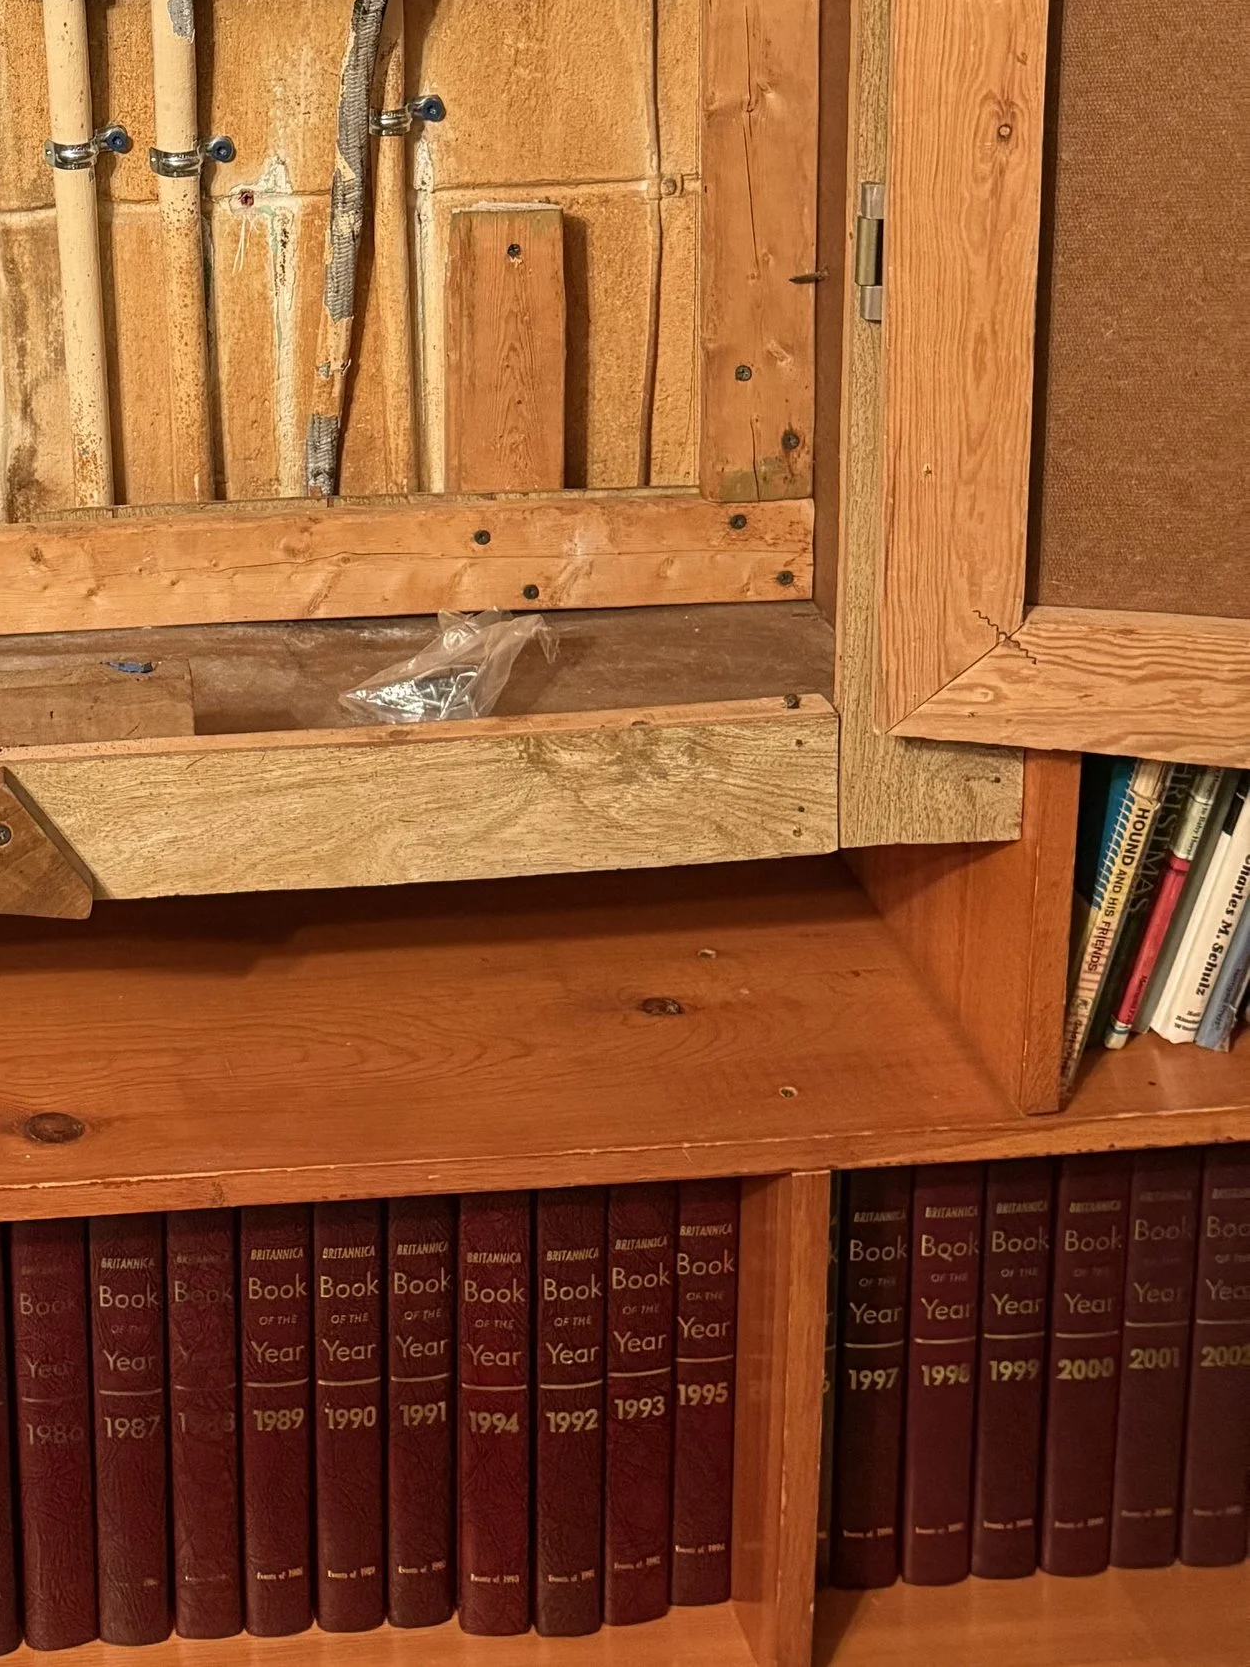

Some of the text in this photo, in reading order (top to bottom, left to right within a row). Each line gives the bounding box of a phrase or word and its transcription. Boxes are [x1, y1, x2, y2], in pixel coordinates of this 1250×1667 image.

[1129, 767, 1190, 913] HRISTMAS
[1087, 807, 1150, 972] HOUND AND HIS FRIENDS
[1214, 920, 1233, 940] M.
[1196, 944, 1223, 996] Schulz
[680, 1224, 733, 1236] BRITANNICA
[1135, 1217, 1191, 1241] Book
[397, 1241, 448, 1255] BRITANNICA
[615, 1236, 667, 1250] BRITANNICA
[850, 1236, 907, 1262] Book
[921, 1234, 979, 1259] Book
[992, 1231, 1049, 1253] Book
[1065, 1229, 1122, 1252] Book
[251, 1247, 304, 1260] BRITANNICA
[323, 1246, 375, 1259] BRITANNICA
[468, 1251, 521, 1264] BRITANNICA
[547, 1248, 599, 1262] BRITANNICA
[676, 1251, 733, 1276] Book
[249, 1275, 307, 1301] Book
[321, 1272, 379, 1299] Book
[395, 1268, 451, 1295] Book
[612, 1264, 670, 1290] Book
[100, 1286, 158, 1309] Book
[465, 1279, 525, 1303] Book
[544, 1276, 602, 1301] Book
[1134, 1283, 1182, 1303] Year
[850, 1302, 902, 1324] Year
[922, 1297, 972, 1320] Year
[991, 1293, 1042, 1315] Year
[1065, 1293, 1112, 1314] Year
[678, 1317, 730, 1339] Year
[251, 1341, 305, 1364] Year
[323, 1339, 376, 1362] Year
[397, 1336, 448, 1359] Year
[546, 1342, 599, 1364] Year
[614, 1331, 666, 1353] Year
[106, 1350, 155, 1372] Year
[468, 1344, 521, 1367] Year
[1130, 1348, 1179, 1370] 2001
[849, 1368, 899, 1390] 1997
[990, 1360, 1039, 1380] 1999
[1058, 1358, 1114, 1380] 2000
[678, 1383, 728, 1405] 1995
[254, 1408, 304, 1431] 1989
[326, 1406, 376, 1429] 1990
[400, 1402, 446, 1426] 1991
[615, 1397, 664, 1420] 1993
[104, 1416, 160, 1438] 1987
[469, 1412, 519, 1433] 1994
[547, 1410, 598, 1432] 1992
